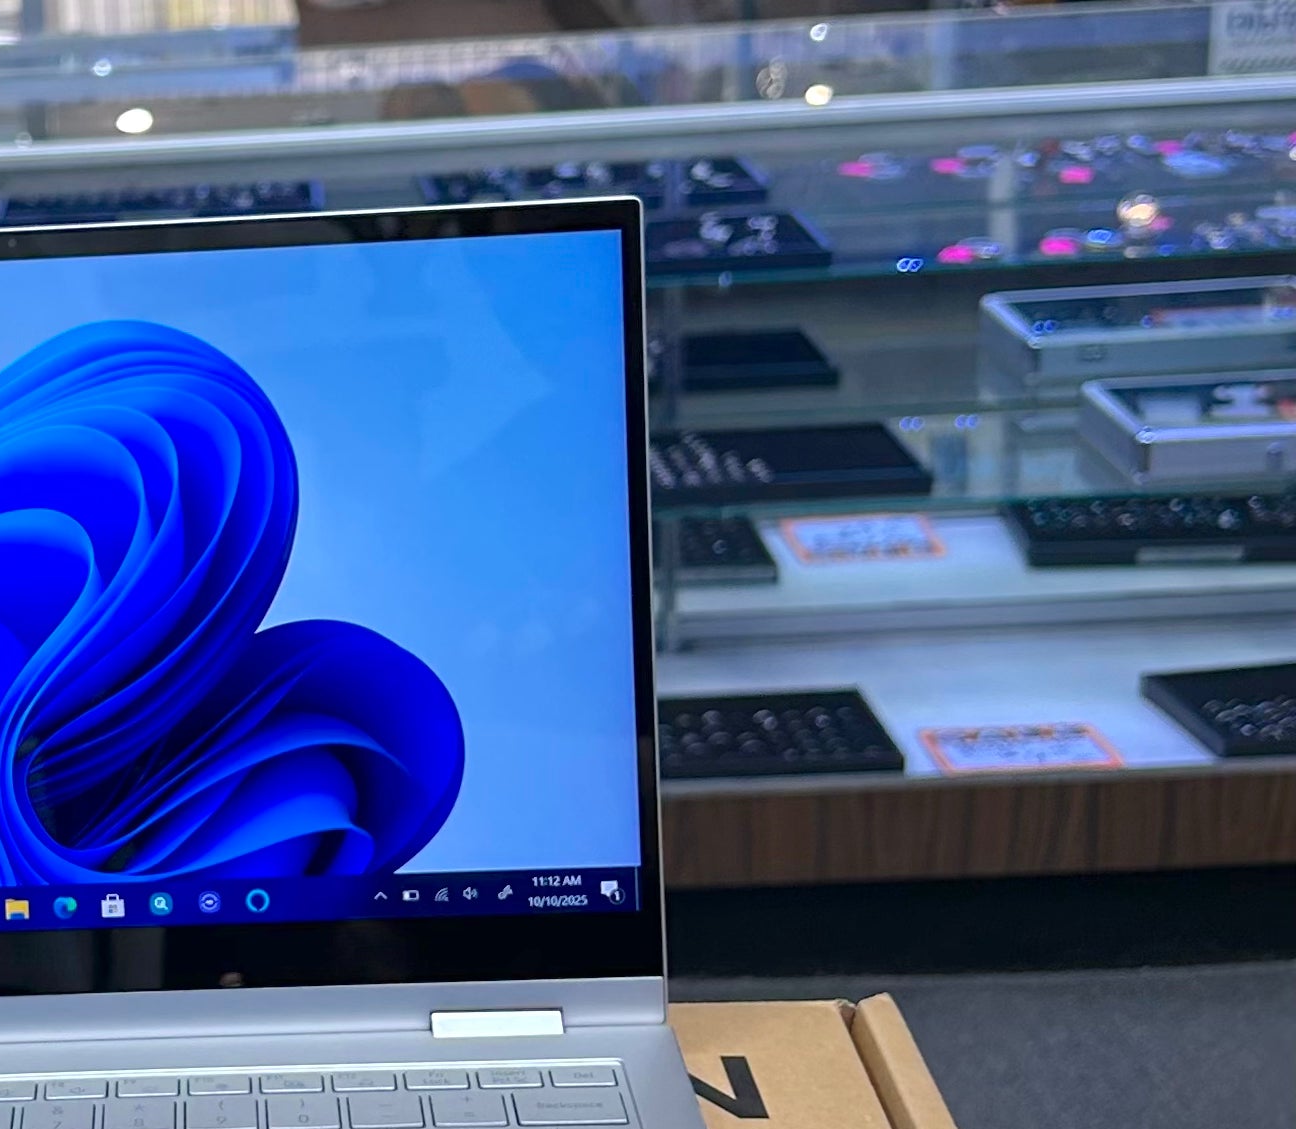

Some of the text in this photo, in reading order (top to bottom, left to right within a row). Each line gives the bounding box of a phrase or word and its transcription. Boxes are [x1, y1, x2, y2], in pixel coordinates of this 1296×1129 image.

[532, 875, 582, 887] 11:12 AM
[528, 895, 588, 908] 10/10/2025
